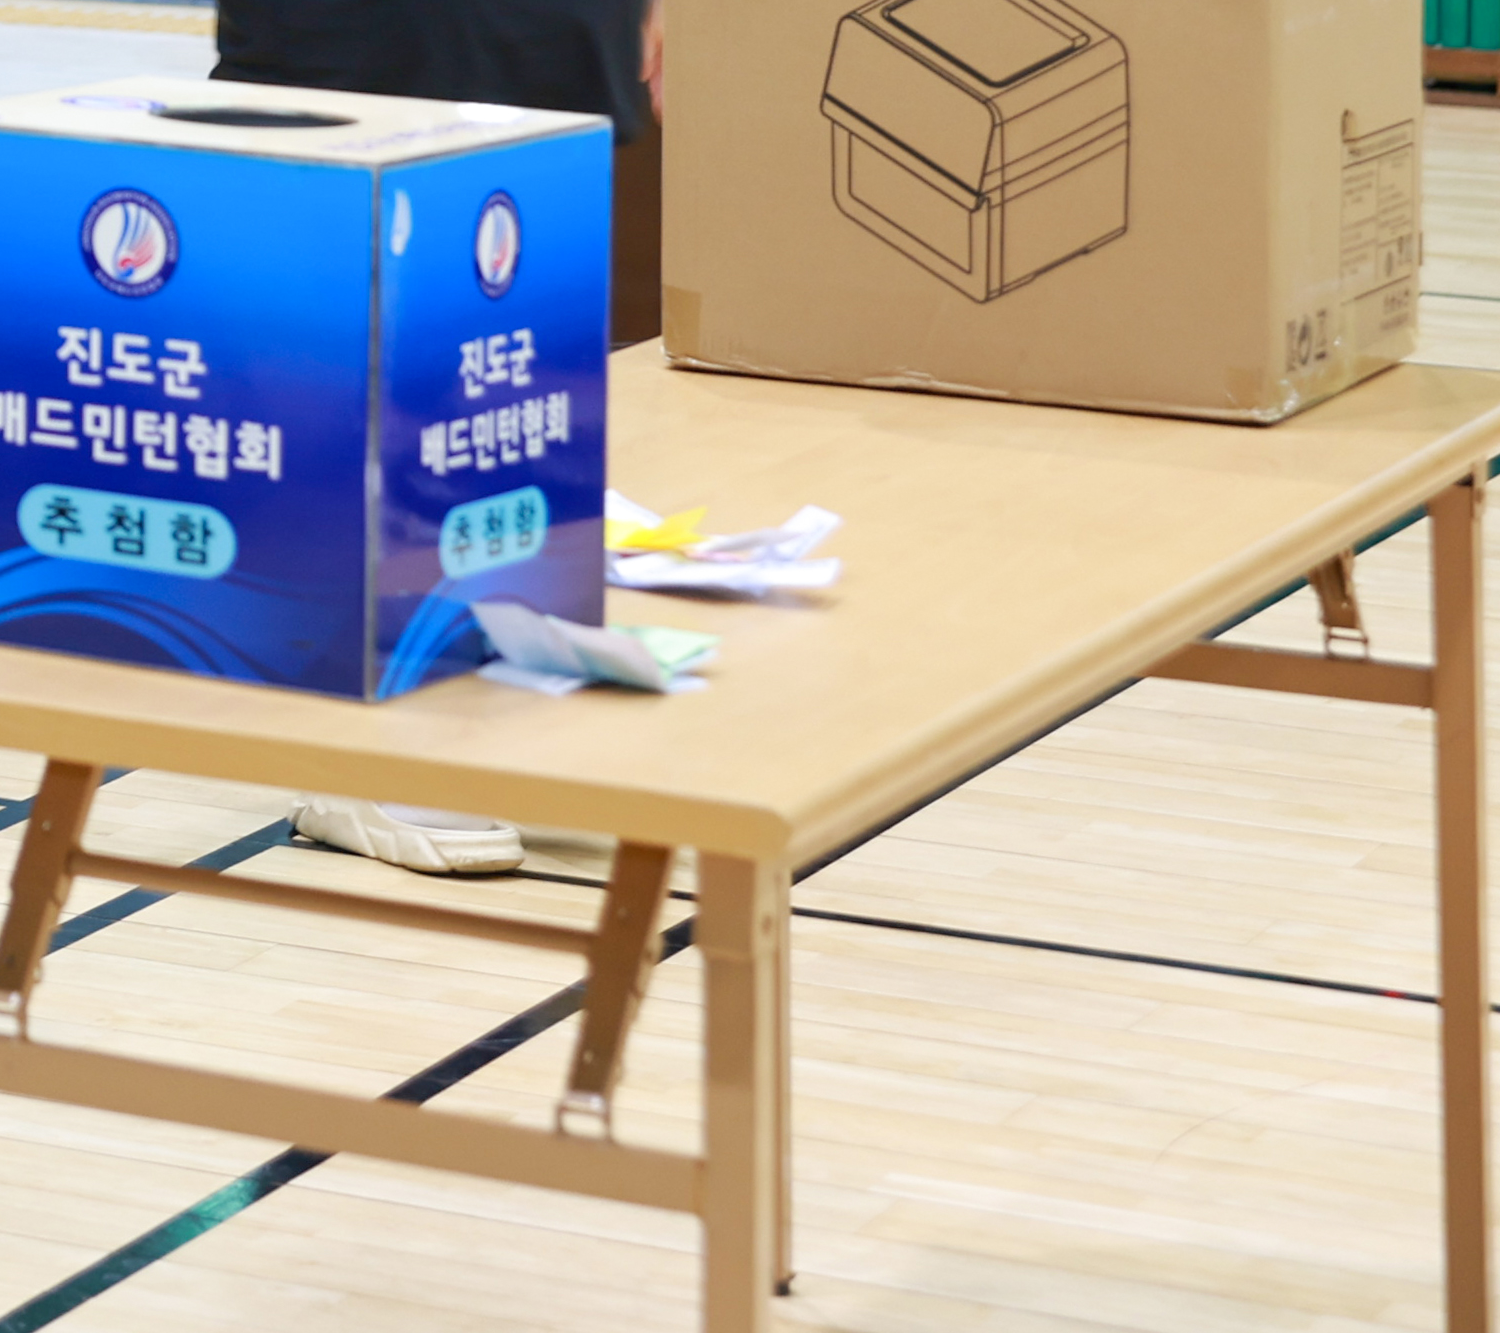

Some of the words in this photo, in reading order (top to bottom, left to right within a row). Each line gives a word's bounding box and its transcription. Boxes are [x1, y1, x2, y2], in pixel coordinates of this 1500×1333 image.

[56, 326, 207, 400] 진도군
[459, 327, 535, 399] 진도군
[420, 390, 570, 477] 배드민턴협회
